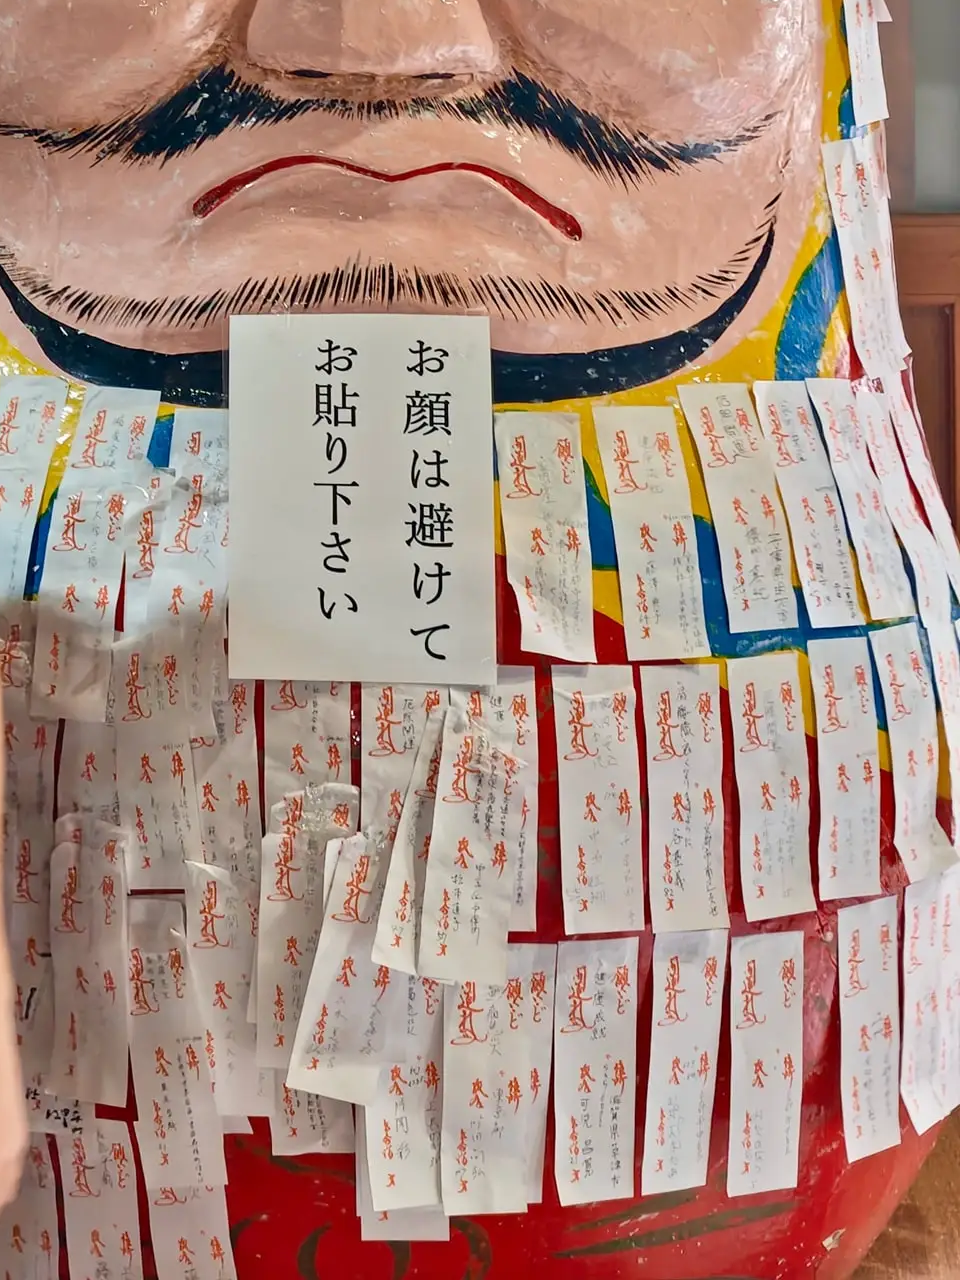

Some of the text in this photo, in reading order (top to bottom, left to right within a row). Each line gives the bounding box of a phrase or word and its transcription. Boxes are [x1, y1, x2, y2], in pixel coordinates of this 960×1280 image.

[312, 338, 360, 620] お貼り下さい
[403, 339, 454, 661] お顔は避けて
